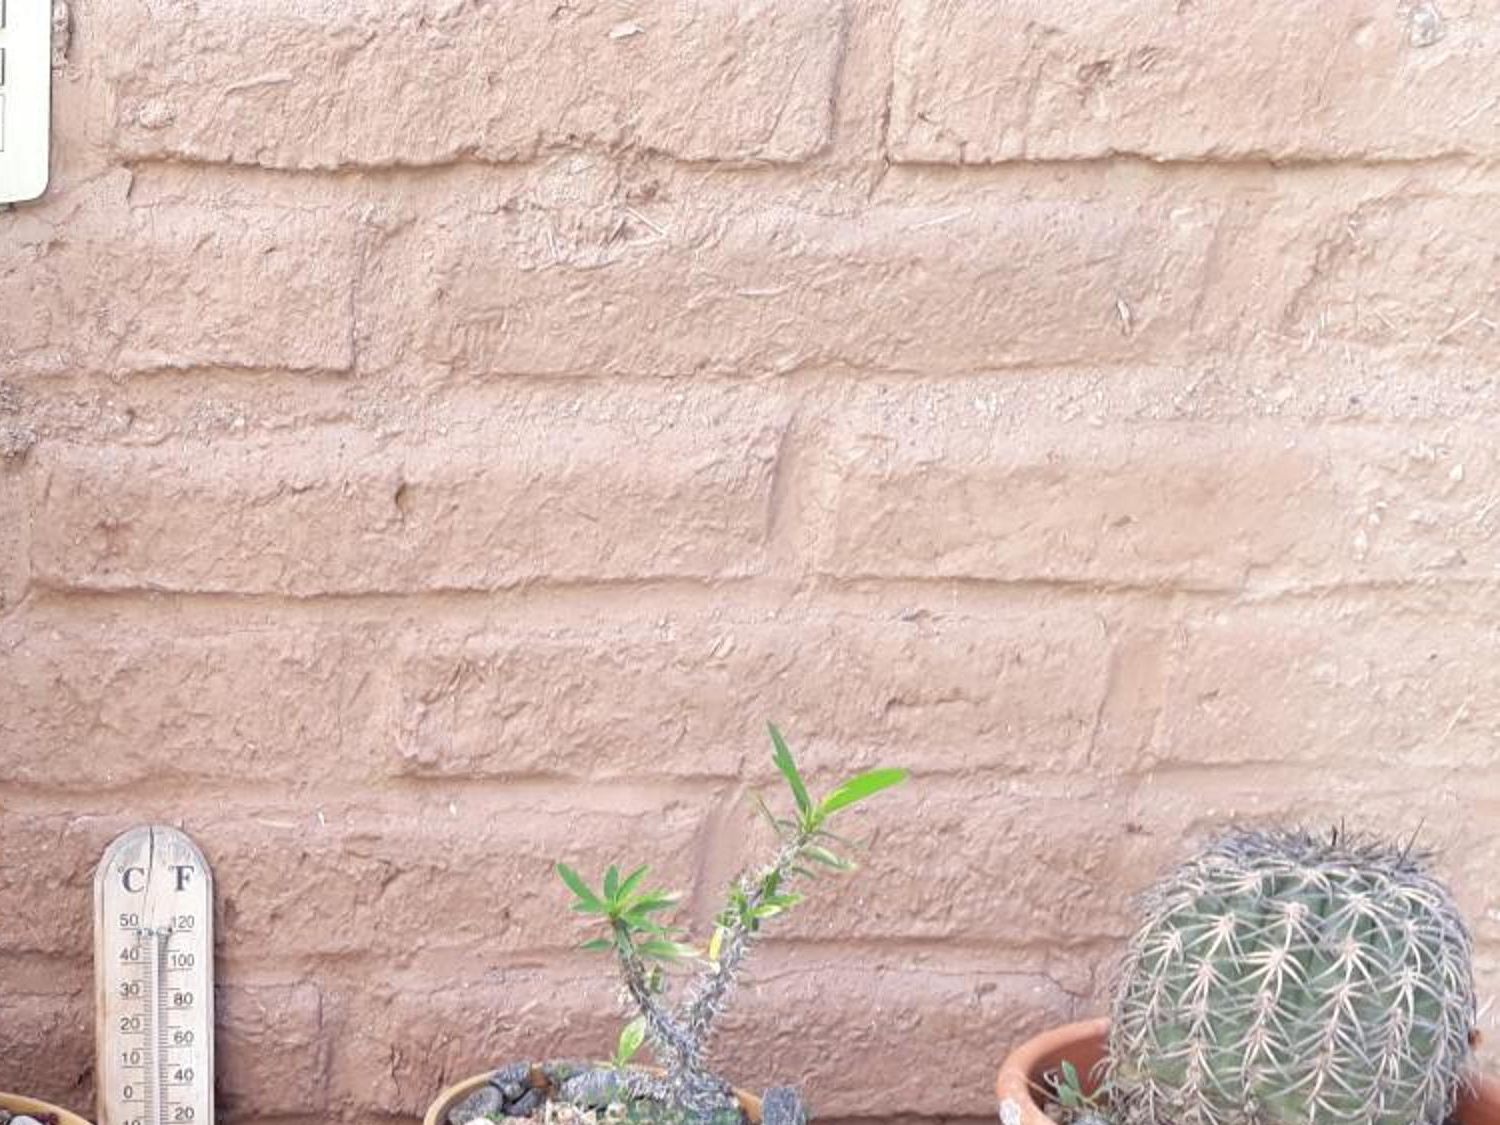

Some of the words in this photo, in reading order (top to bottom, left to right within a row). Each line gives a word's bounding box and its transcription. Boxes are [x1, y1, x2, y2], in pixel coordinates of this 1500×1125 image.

[120, 914, 138, 927] 50
[172, 916, 195, 928] 120
[120, 948, 139, 961] 40
[171, 954, 194, 966] 100
[120, 983, 139, 996] 30
[174, 993, 193, 1005] 80
[120, 1018, 140, 1030] 20
[174, 1031, 193, 1043] 60
[122, 1052, 140, 1065] 10
[174, 1069, 194, 1081] 40
[124, 1087, 132, 1099] 0
[175, 1107, 194, 1120] 20
